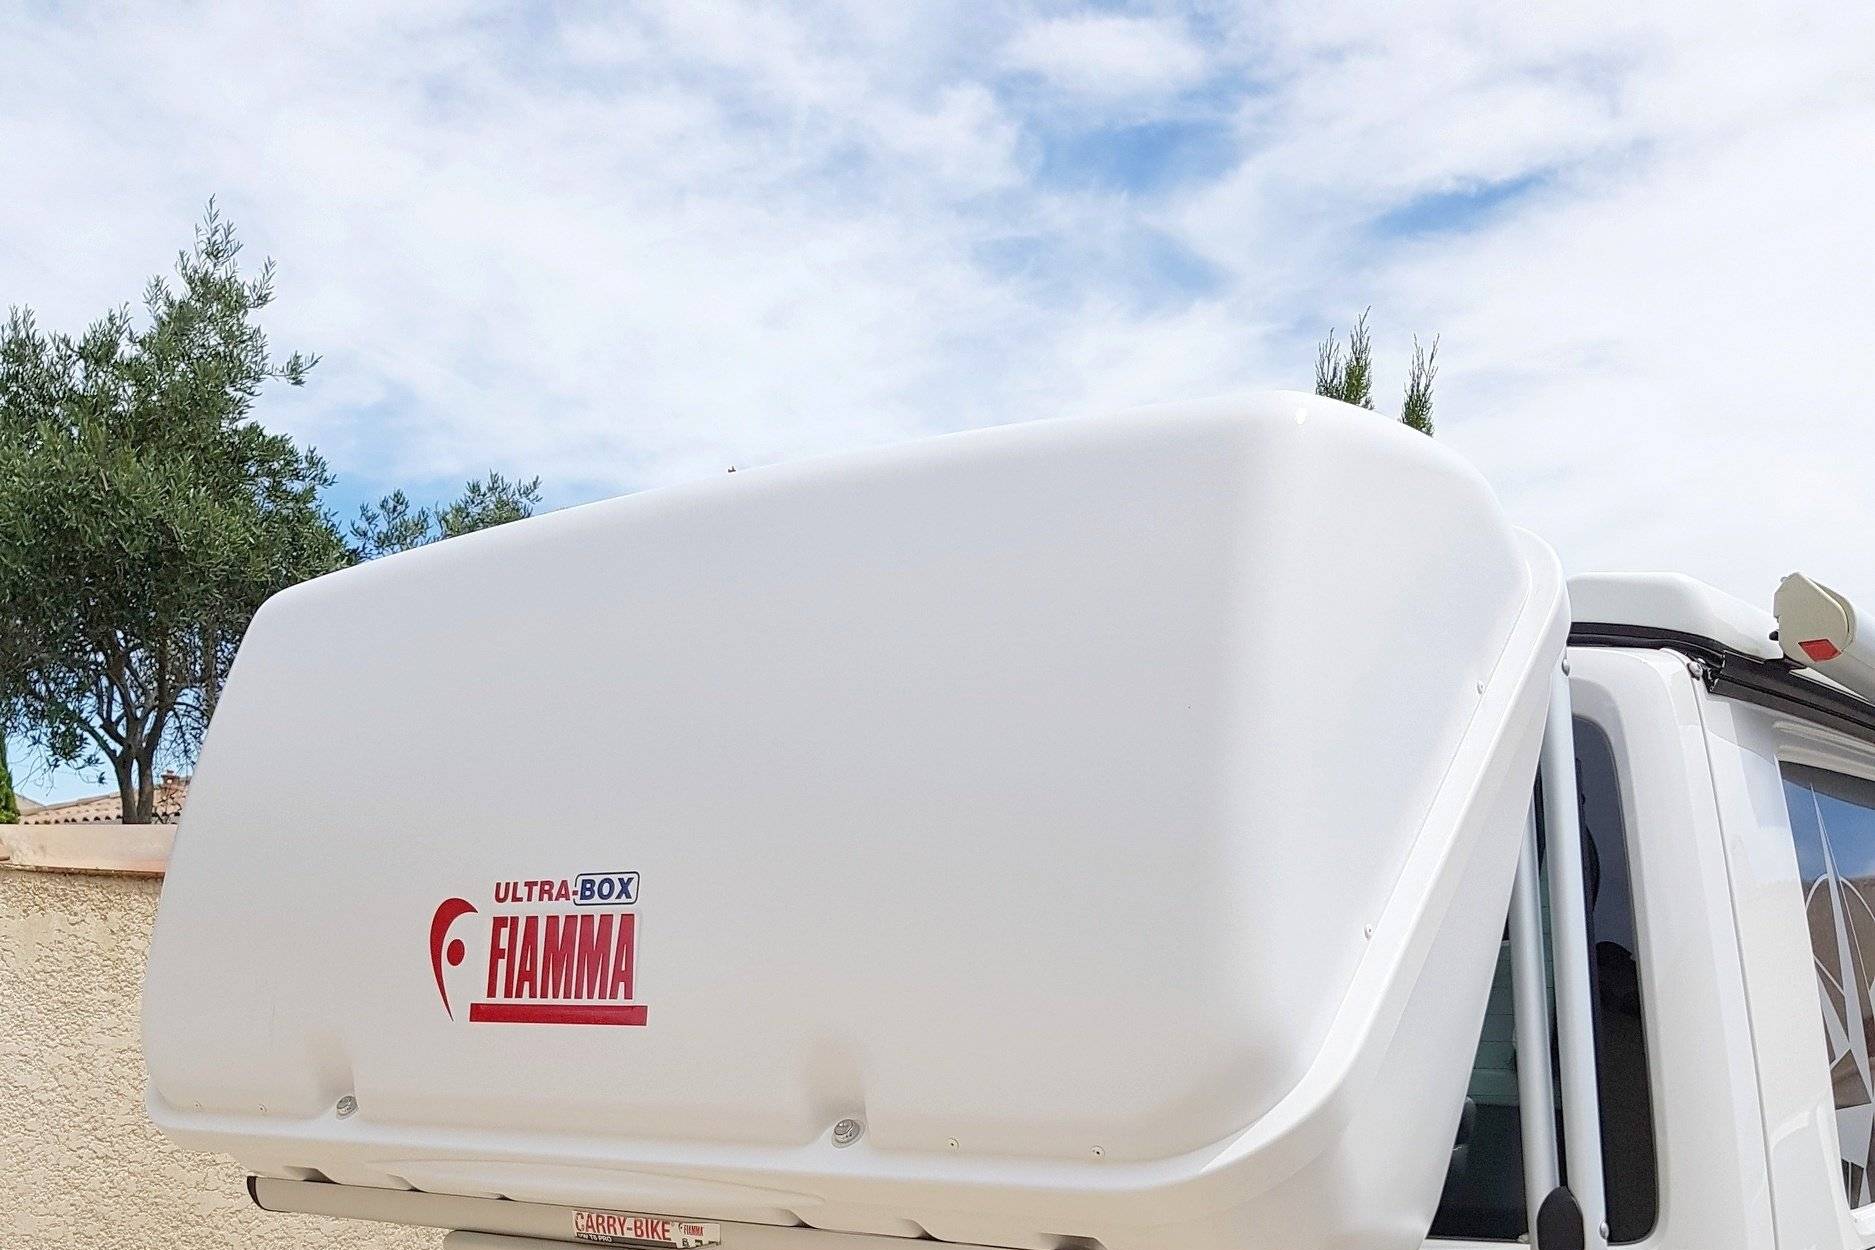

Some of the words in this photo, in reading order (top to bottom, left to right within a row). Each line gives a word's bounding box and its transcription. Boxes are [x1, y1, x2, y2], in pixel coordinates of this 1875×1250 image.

[494, 876, 635, 904] ULTRA-BOX
[486, 913, 635, 1001] FIAMMA
[574, 1212, 672, 1242] CARRY-BIKE
